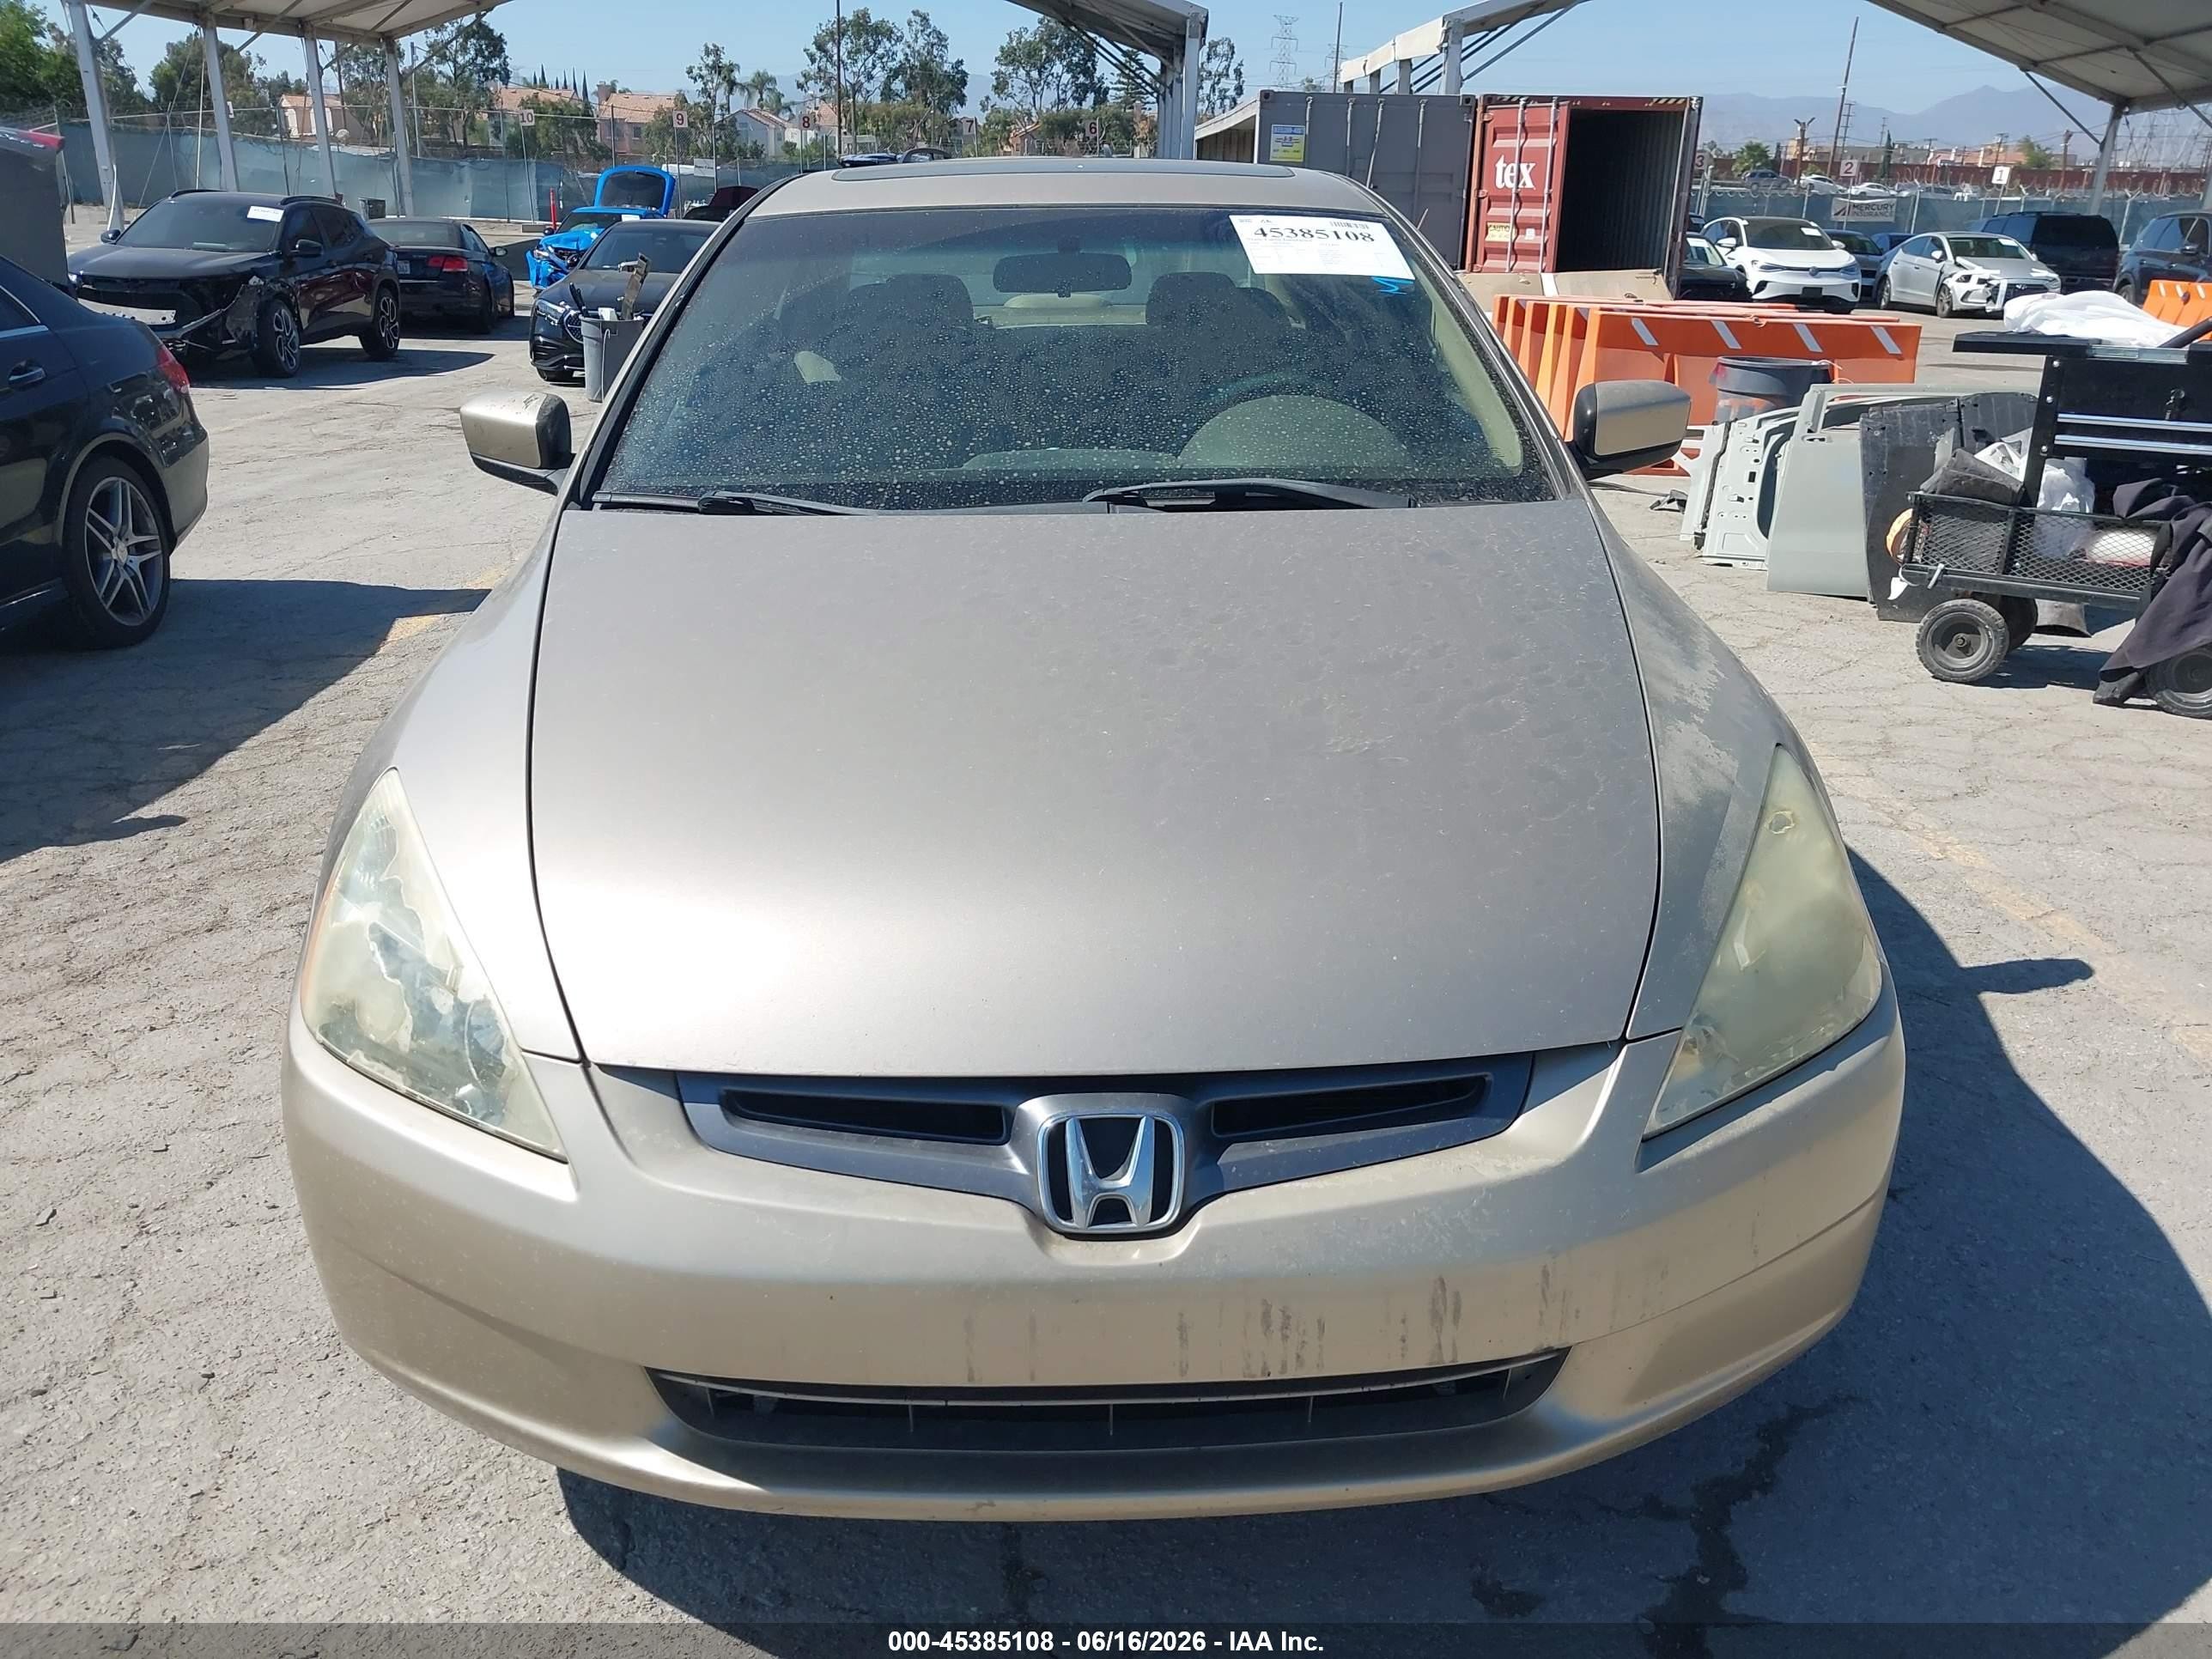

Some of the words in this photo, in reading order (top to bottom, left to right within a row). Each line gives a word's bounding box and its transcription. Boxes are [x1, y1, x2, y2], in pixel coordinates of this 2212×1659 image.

[520, 112, 534, 123] 10
[676, 112, 684, 125] 9
[802, 116, 811, 129] 8
[966, 120, 974, 133] 7
[1089, 122, 1097, 134] 6
[1695, 155, 1705, 167] 3
[1843, 162, 1854, 173] 2
[1997, 169, 2005, 181] 1
[1852, 203, 1895, 211] MERCURY
[1254, 226, 1376, 243] 45385108
